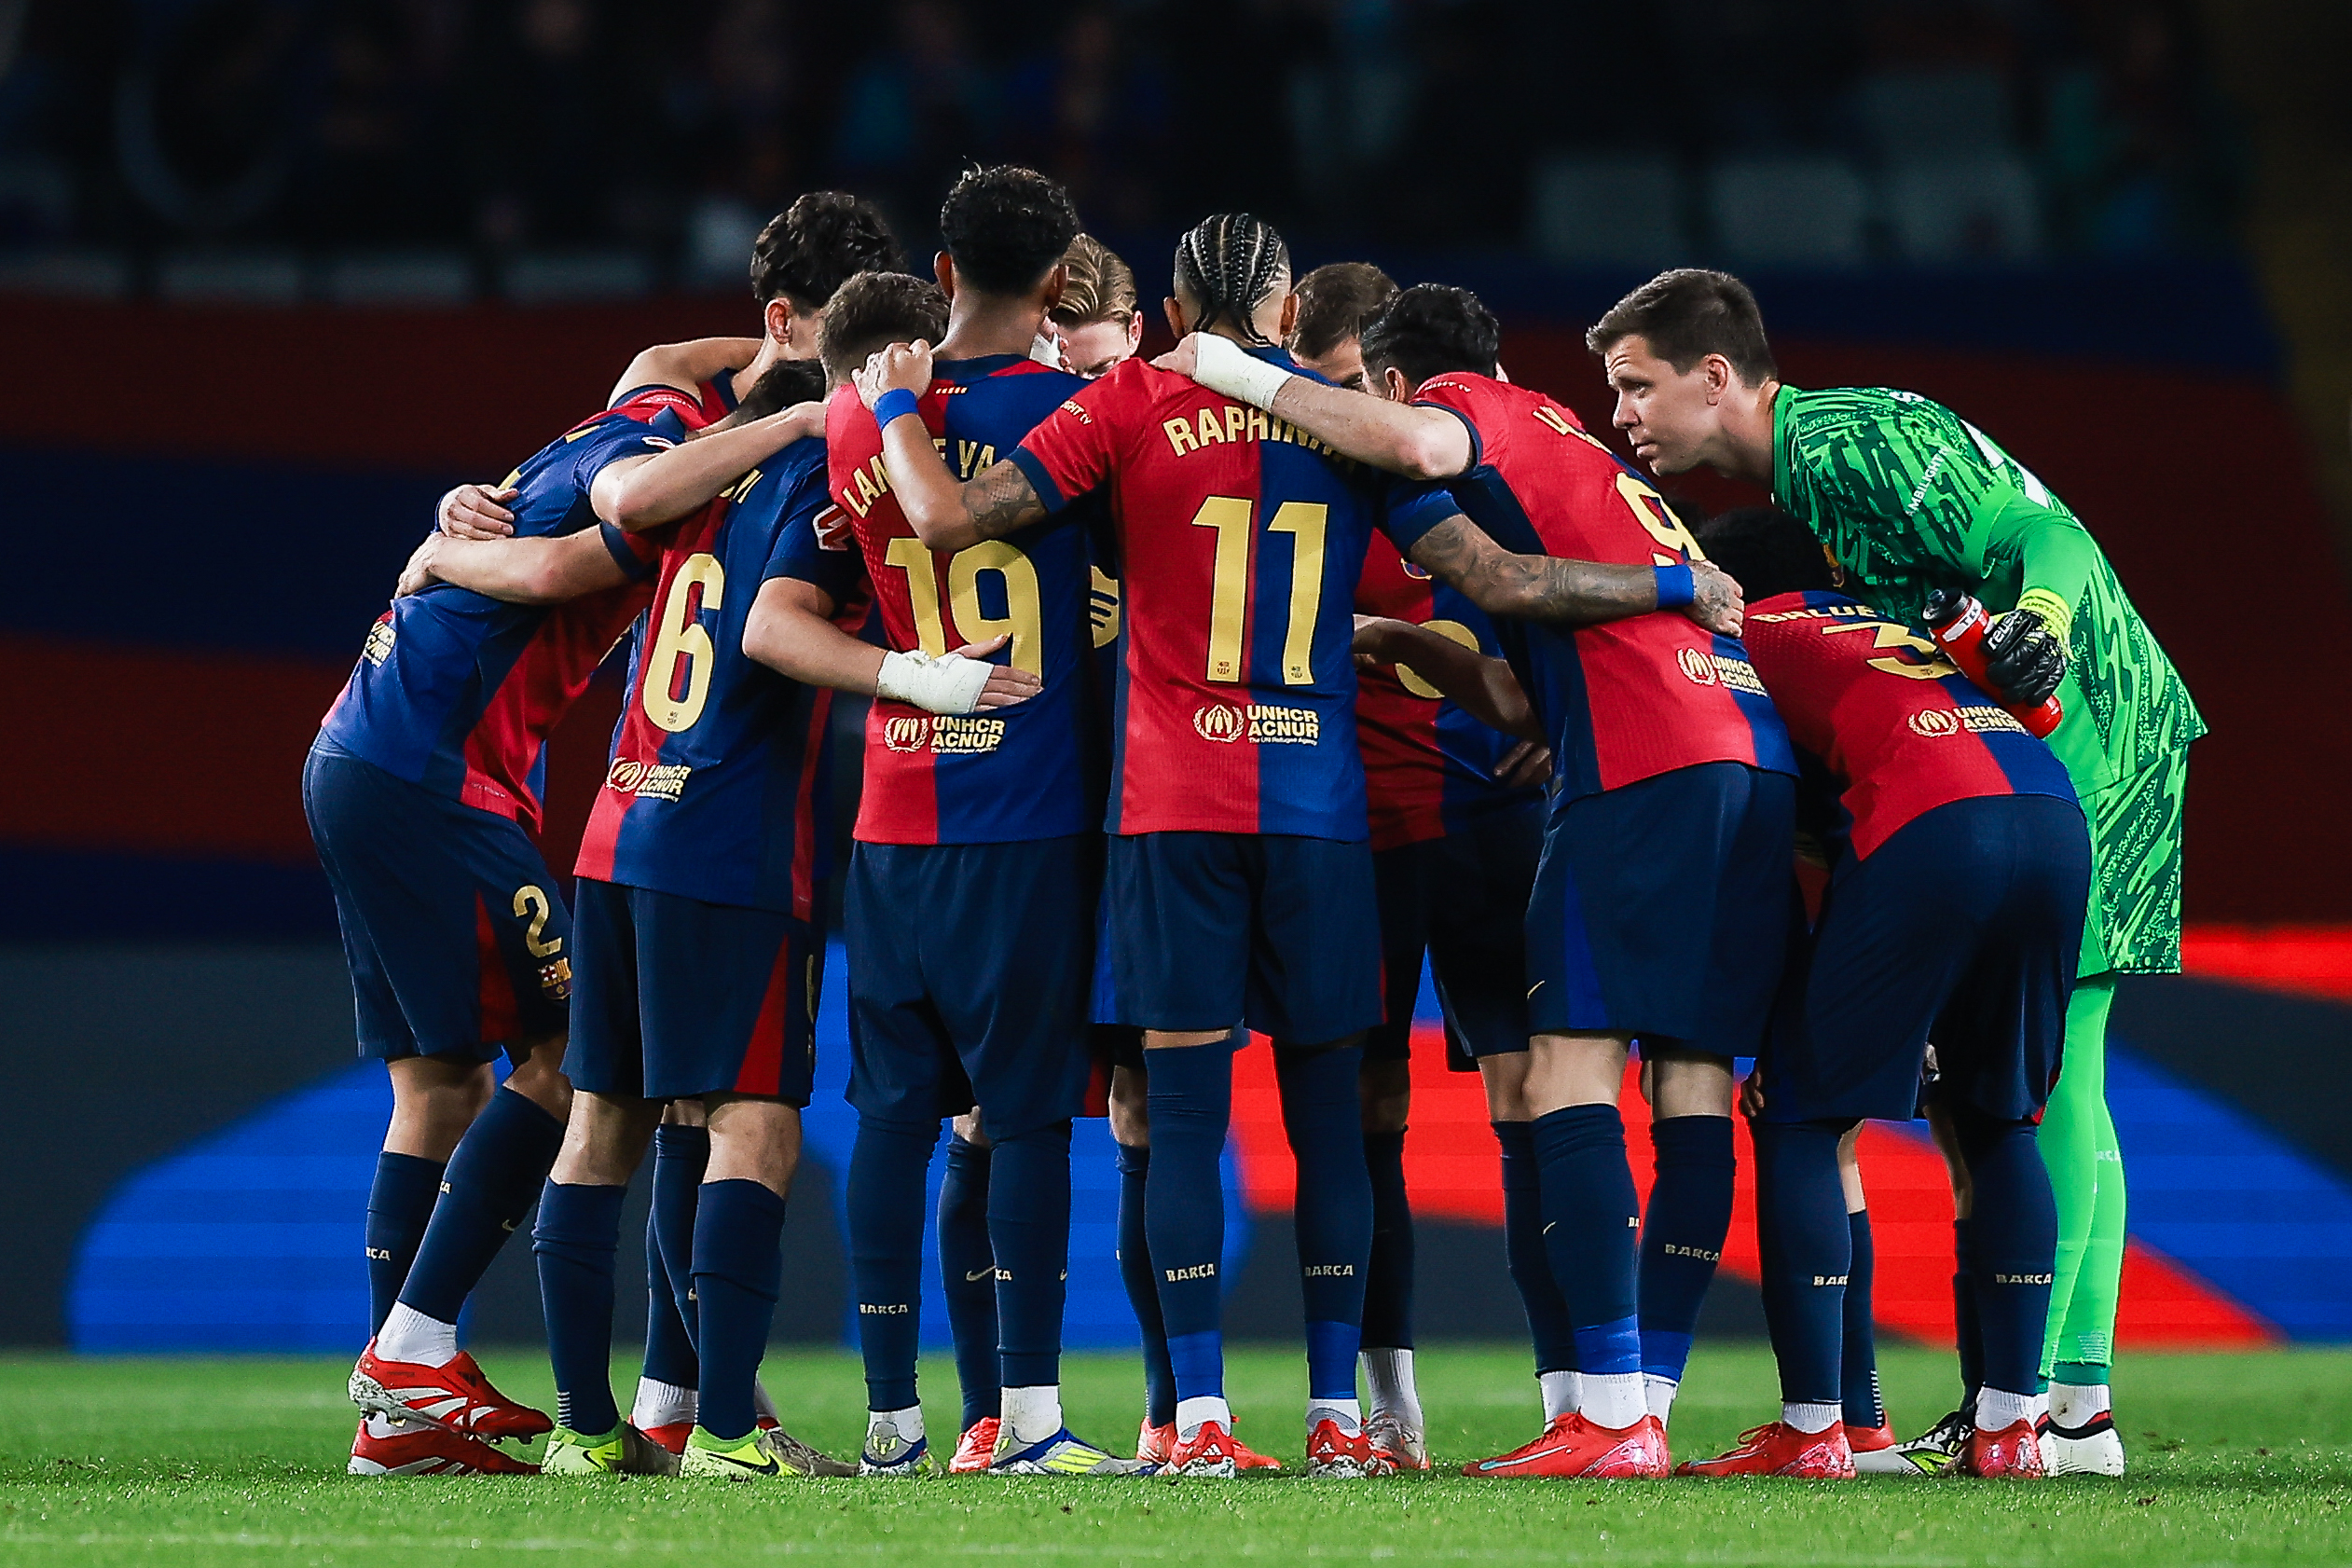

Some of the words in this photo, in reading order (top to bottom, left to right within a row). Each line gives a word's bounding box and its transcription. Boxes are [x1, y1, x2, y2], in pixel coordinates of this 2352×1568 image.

[1616, 472, 1707, 567] 9
[1191, 496, 1328, 685] 11
[885, 537, 1042, 686] 19
[642, 553, 724, 733] 6
[1822, 620, 1958, 681] 3
[1709, 653, 1757, 680] UNHCR
[1717, 669, 1766, 692] ACNUR
[931, 716, 1006, 736] UNHCR
[1246, 704, 1319, 723] UNHCR
[1247, 721, 1319, 739] ACNUR
[646, 763, 692, 780] UNHCR
[636, 777, 684, 795] ACNUR
[513, 885, 562, 958] 2
[1165, 1263, 1216, 1283] BARÇA
